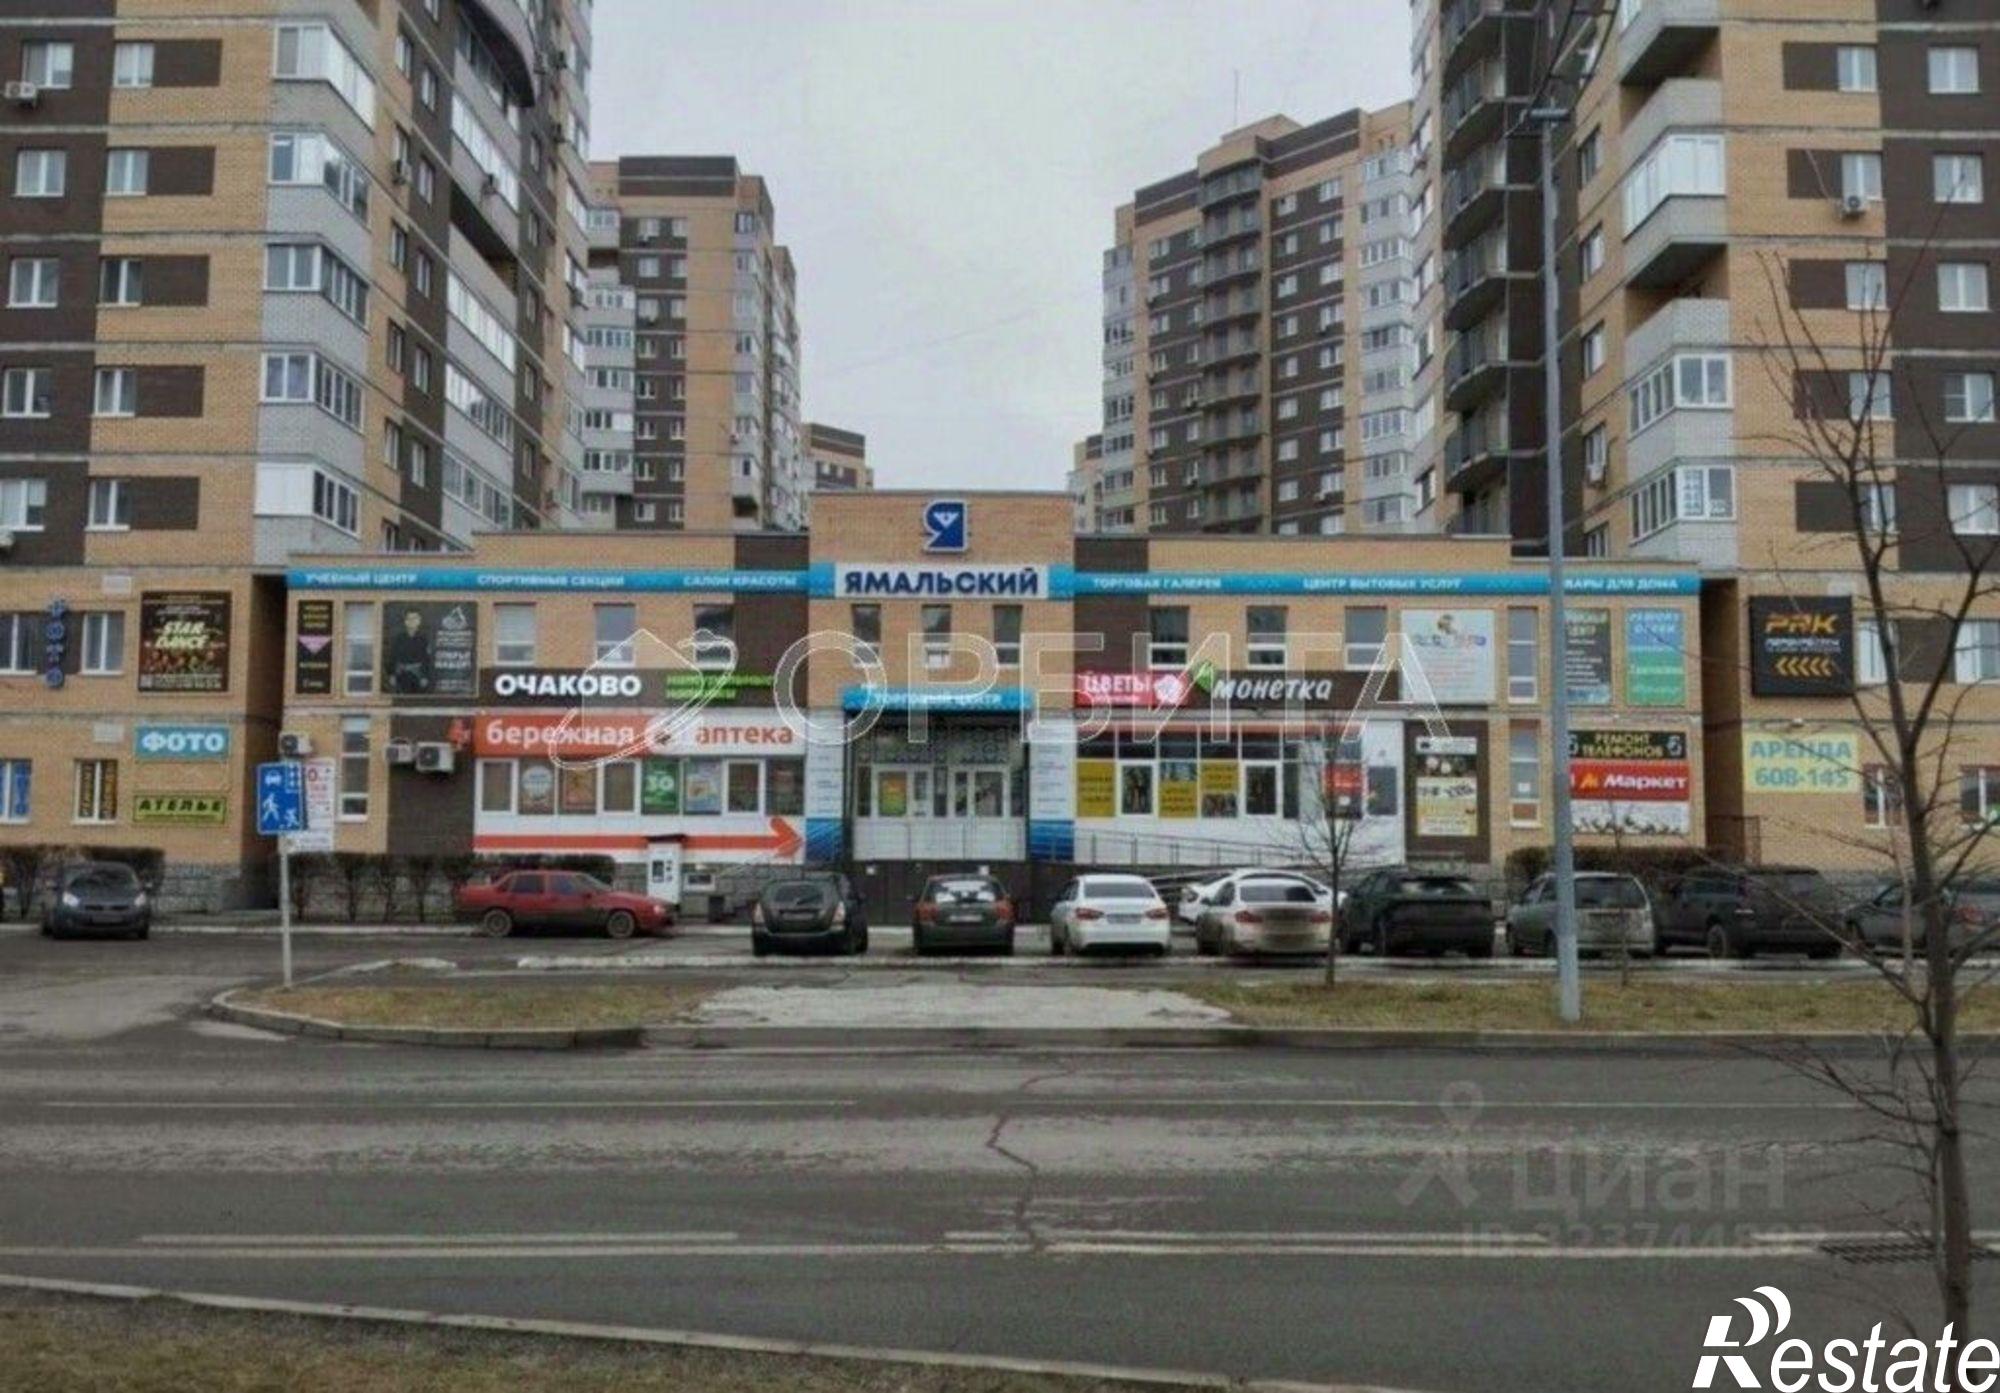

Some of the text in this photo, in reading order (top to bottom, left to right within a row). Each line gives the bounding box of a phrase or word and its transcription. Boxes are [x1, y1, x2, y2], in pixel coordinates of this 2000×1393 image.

[306, 572, 416, 584] УЧЕБНЫЙ ЦЕНТР
[477, 575, 624, 586] СПОРТИВНЫЕ СЕКЦИИ
[683, 575, 797, 587] САЛОН КРАСОТЫ
[845, 568, 1038, 594] ЯМАЛЬСКИЙ
[1093, 577, 1221, 588] ТОРГОВАЯ ГАЛЕРЕЯ
[1303, 578, 1346, 590] ЦЕНТР
[1420, 578, 1461, 589] УСЛУГ
[1606, 578, 1635, 590] ДЛЯ
[1638, 578, 1678, 590] ДОМА
[495, 674, 642, 696] ОЧАКОВО
[1084, 673, 1152, 694] ЦВЕТЫ
[1212, 677, 1332, 701] монетка
[486, 719, 634, 749] бережная
[696, 724, 794, 745] аптека
[1595, 733, 1651, 743] РЕМОНТ
[140, 732, 226, 753] ФОТО
[1582, 744, 1663, 757] ТЕЛЕФОНОВ
[1750, 740, 1852, 759] АРЕНДА
[1604, 773, 1687, 791] Маркет
[138, 799, 225, 813] АТЕЛЬЕ
